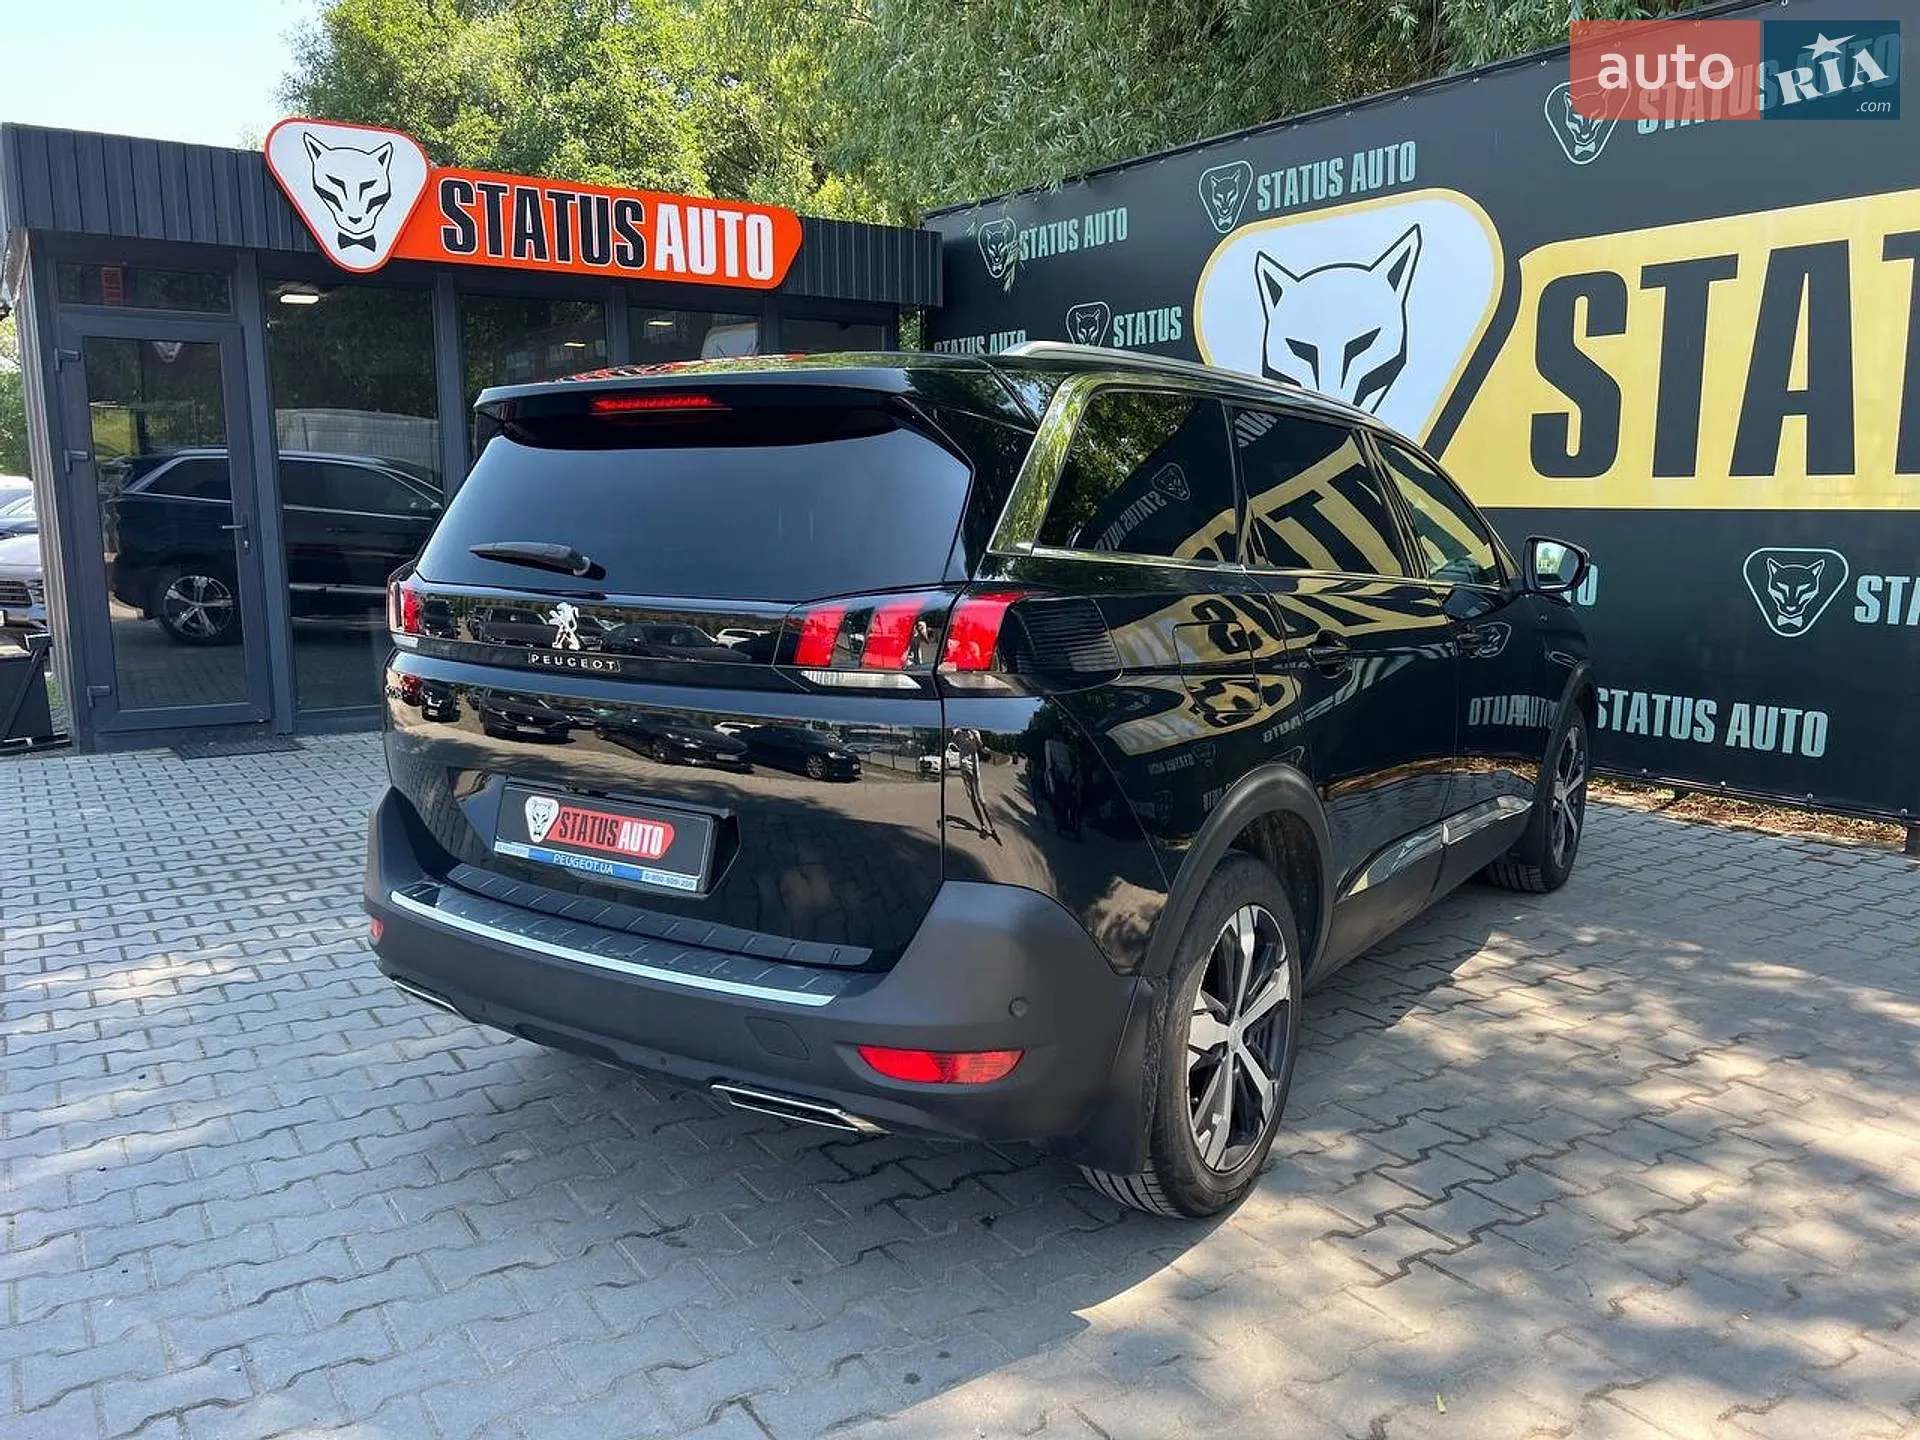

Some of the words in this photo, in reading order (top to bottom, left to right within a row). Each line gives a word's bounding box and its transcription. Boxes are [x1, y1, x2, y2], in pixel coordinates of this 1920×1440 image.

[1256, 158, 1344, 211] STATUS
[1349, 140, 1417, 195] AUTO
[438, 176, 647, 271] STATUS
[654, 202, 774, 281] AUTO
[1018, 217, 1079, 262] STATUS
[1082, 207, 1129, 248] AUTO
[1113, 306, 1182, 349] STATUS
[531, 653, 616, 671] PEUGEOT
[1725, 702, 1830, 758] AUTO
[558, 810, 620, 848] STATUS
[617, 821, 665, 856] AUTO
